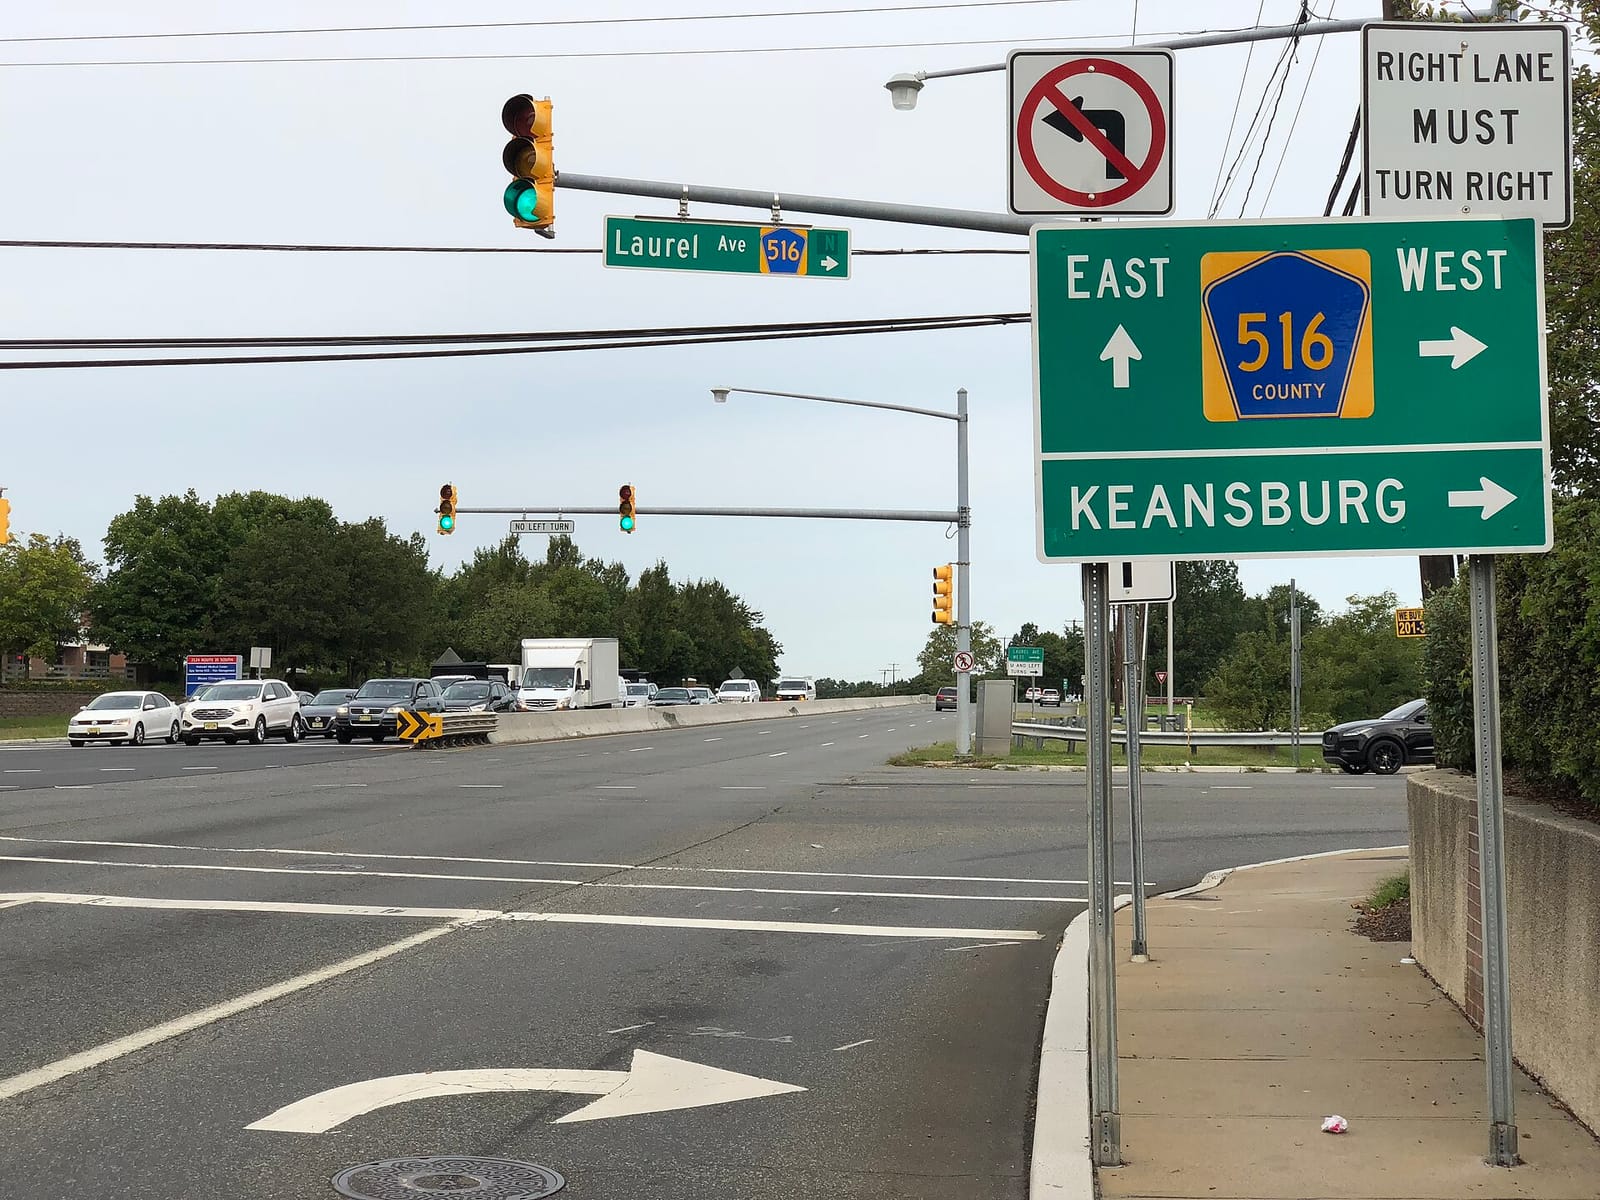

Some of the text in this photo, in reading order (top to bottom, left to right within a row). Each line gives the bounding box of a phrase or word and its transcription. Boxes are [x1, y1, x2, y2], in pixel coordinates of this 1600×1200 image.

[1377, 51, 1554, 83] RIGHT LANE
[1413, 109, 1519, 145] MUST
[1376, 170, 1553, 201] TURN RIGHT
[615, 229, 801, 262] Laurel Ave 516
[1066, 254, 1170, 299] EAST
[1396, 247, 1508, 292] WEST
[1237, 311, 1334, 372] 516
[1253, 383, 1326, 400] COUNTY
[1069, 478, 1407, 530] KEANSBURG
[515, 523, 569, 531] NO LEFT TURN
[1398, 611, 1408, 621] WE
